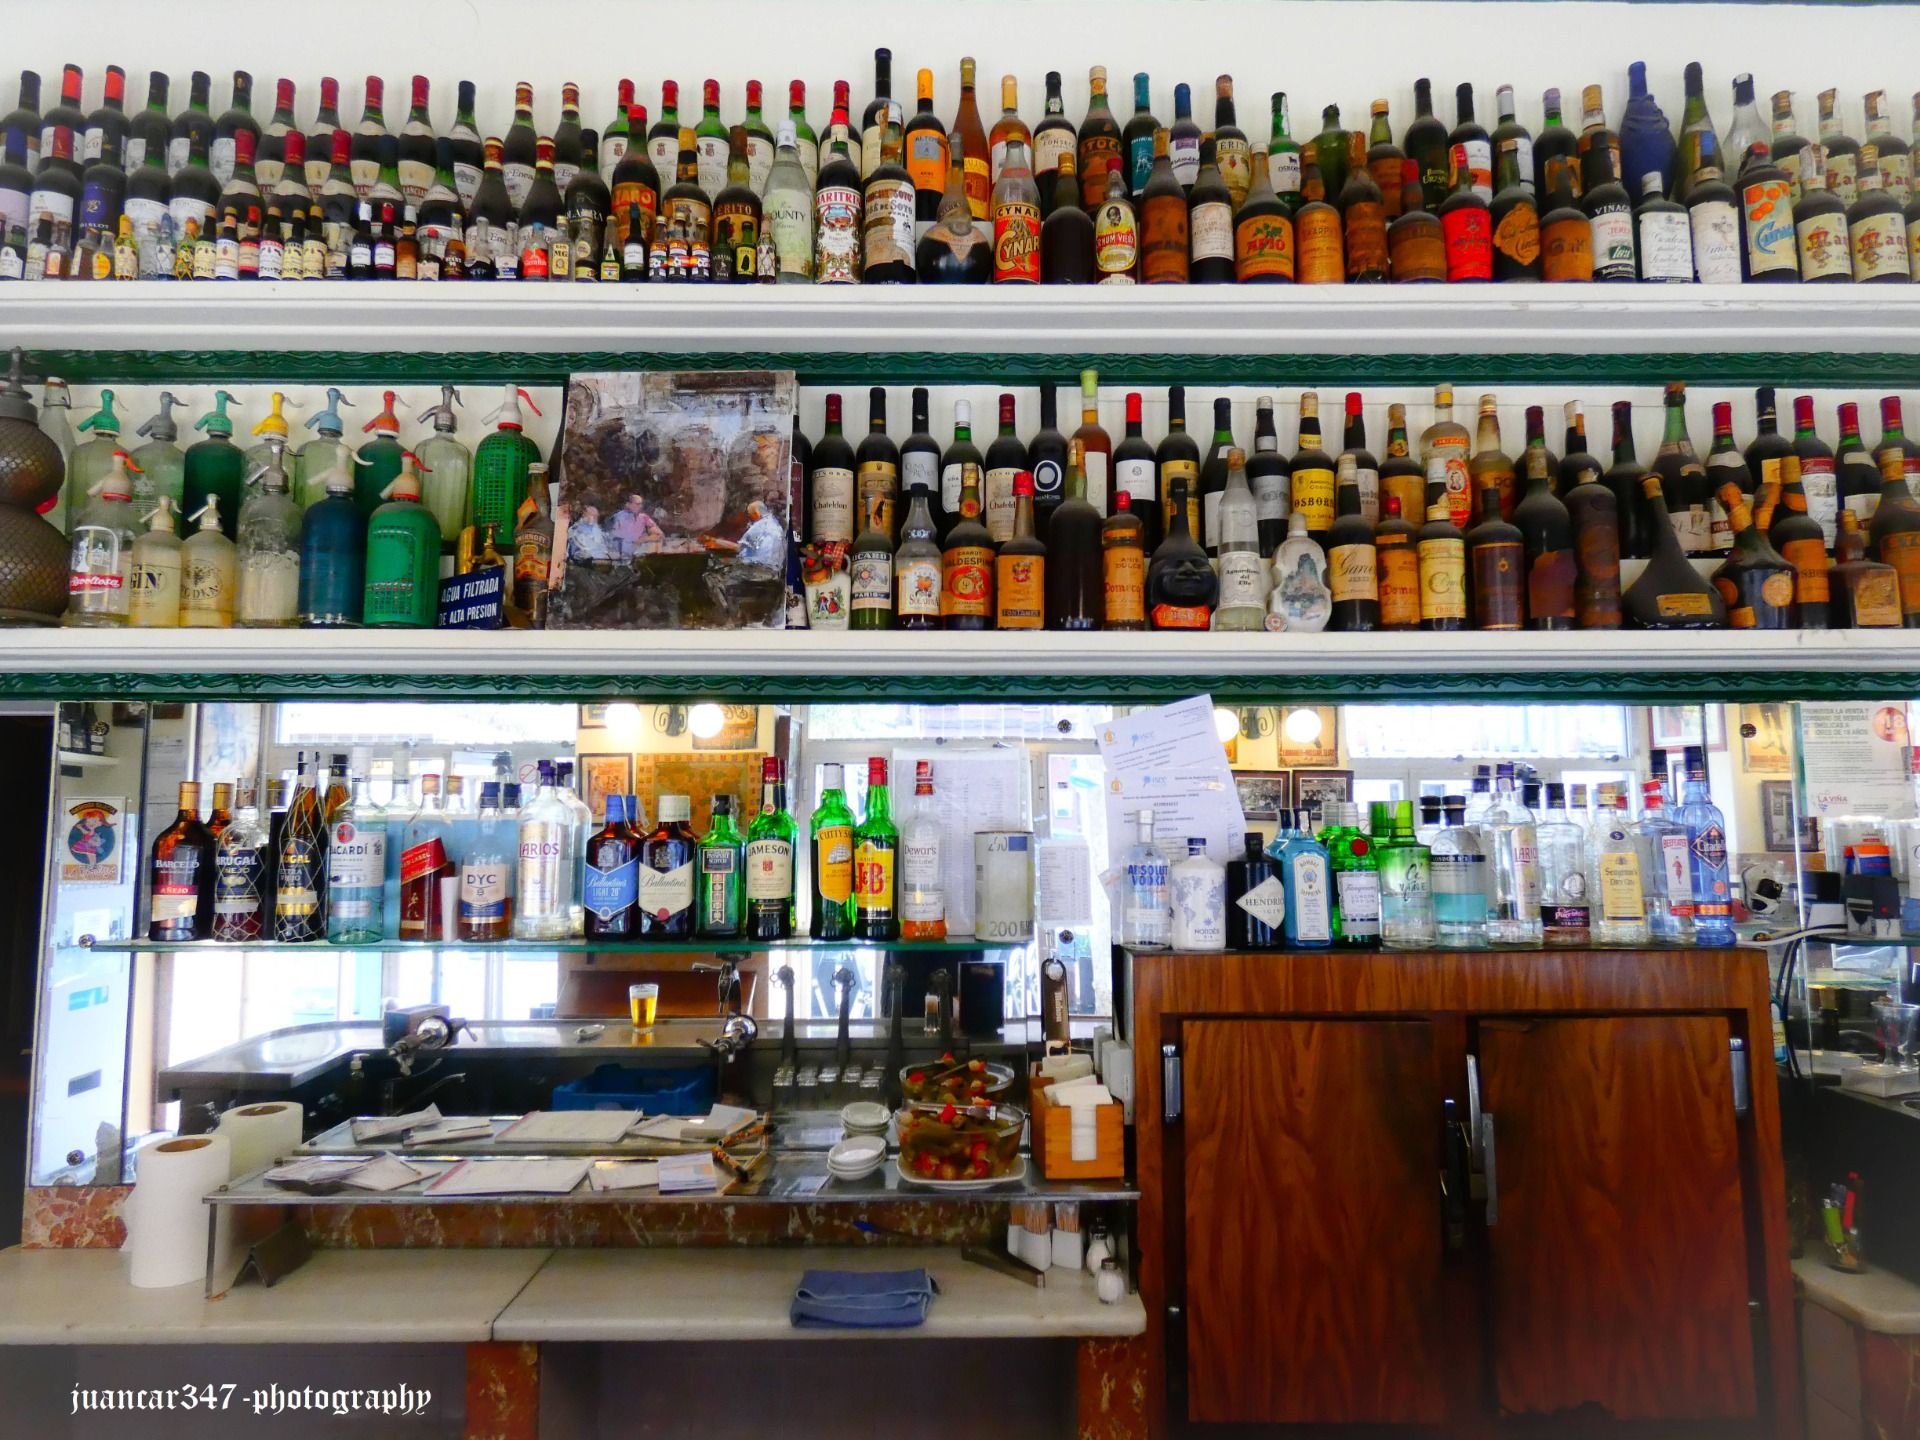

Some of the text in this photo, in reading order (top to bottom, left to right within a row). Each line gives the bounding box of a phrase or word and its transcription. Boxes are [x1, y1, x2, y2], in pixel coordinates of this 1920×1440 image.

[771, 208, 806, 223] OUNTY
[441, 576, 499, 603] AGUA FILTRADA
[449, 609, 465, 625] ALTA
[466, 602, 497, 621] PRESION
[520, 843, 559, 857] LARIOS
[748, 844, 790, 857] JAMESON
[904, 844, 937, 856] Dewar's
[155, 857, 200, 869] BARCELÓ
[1127, 864, 1168, 876] ABSOLUT
[467, 874, 497, 885] DYC
[640, 874, 687, 888] Ballantine's
[1131, 876, 1166, 888] VODKA
[592, 887, 609, 897] LIGHT
[988, 920, 1018, 937] 200
